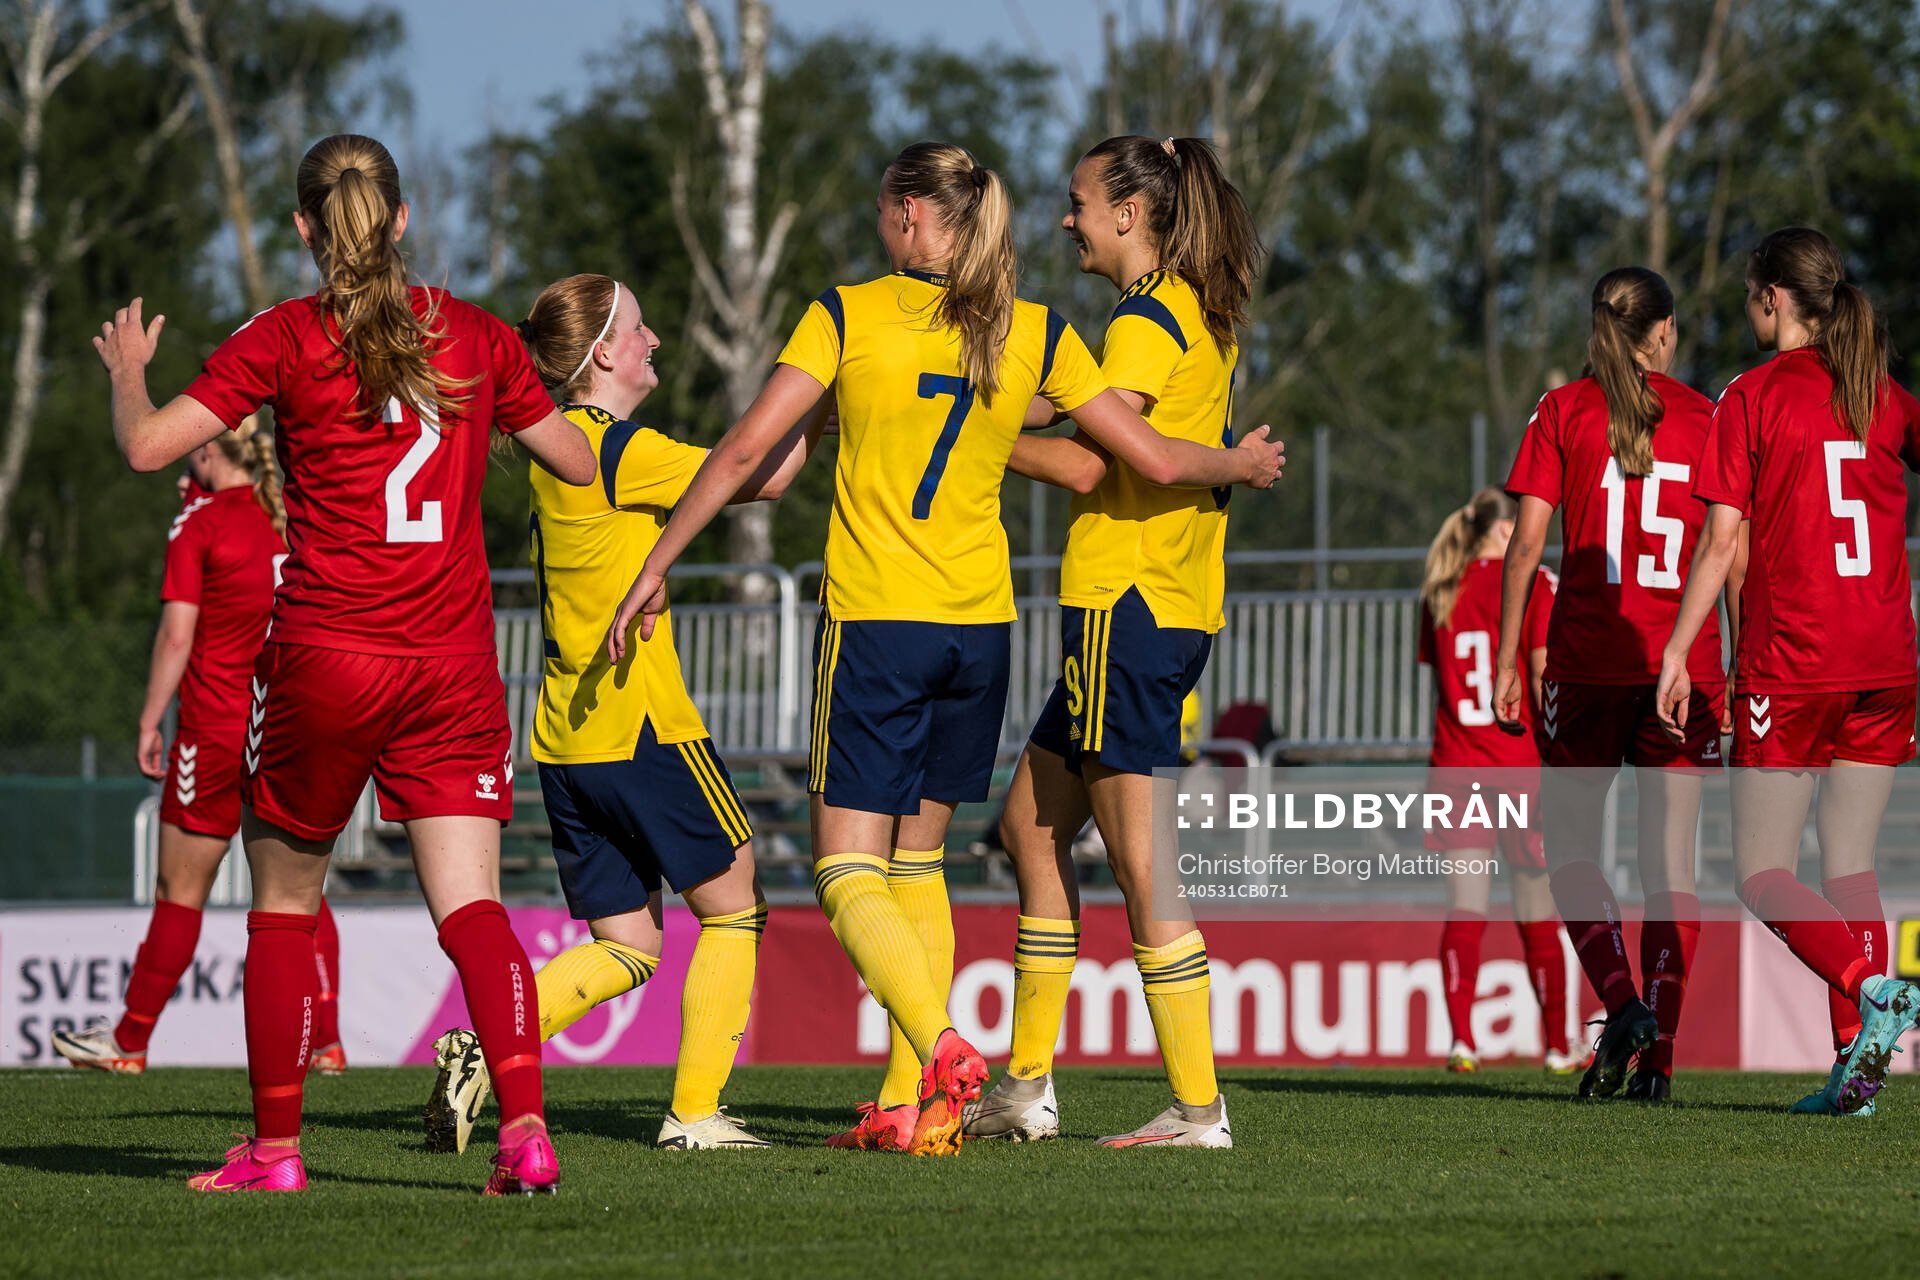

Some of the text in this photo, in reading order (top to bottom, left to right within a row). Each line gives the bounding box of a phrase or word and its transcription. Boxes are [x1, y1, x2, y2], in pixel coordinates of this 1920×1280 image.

[382, 384, 443, 543] 2
[911, 372, 976, 520] 7
[1600, 455, 1690, 589] 15
[1823, 440, 1872, 577] 5
[1065, 655, 1083, 717] 9
[1455, 630, 1495, 727] 3
[296, 996, 312, 1068] DANMARK
[509, 962, 526, 1037] DANMARK
